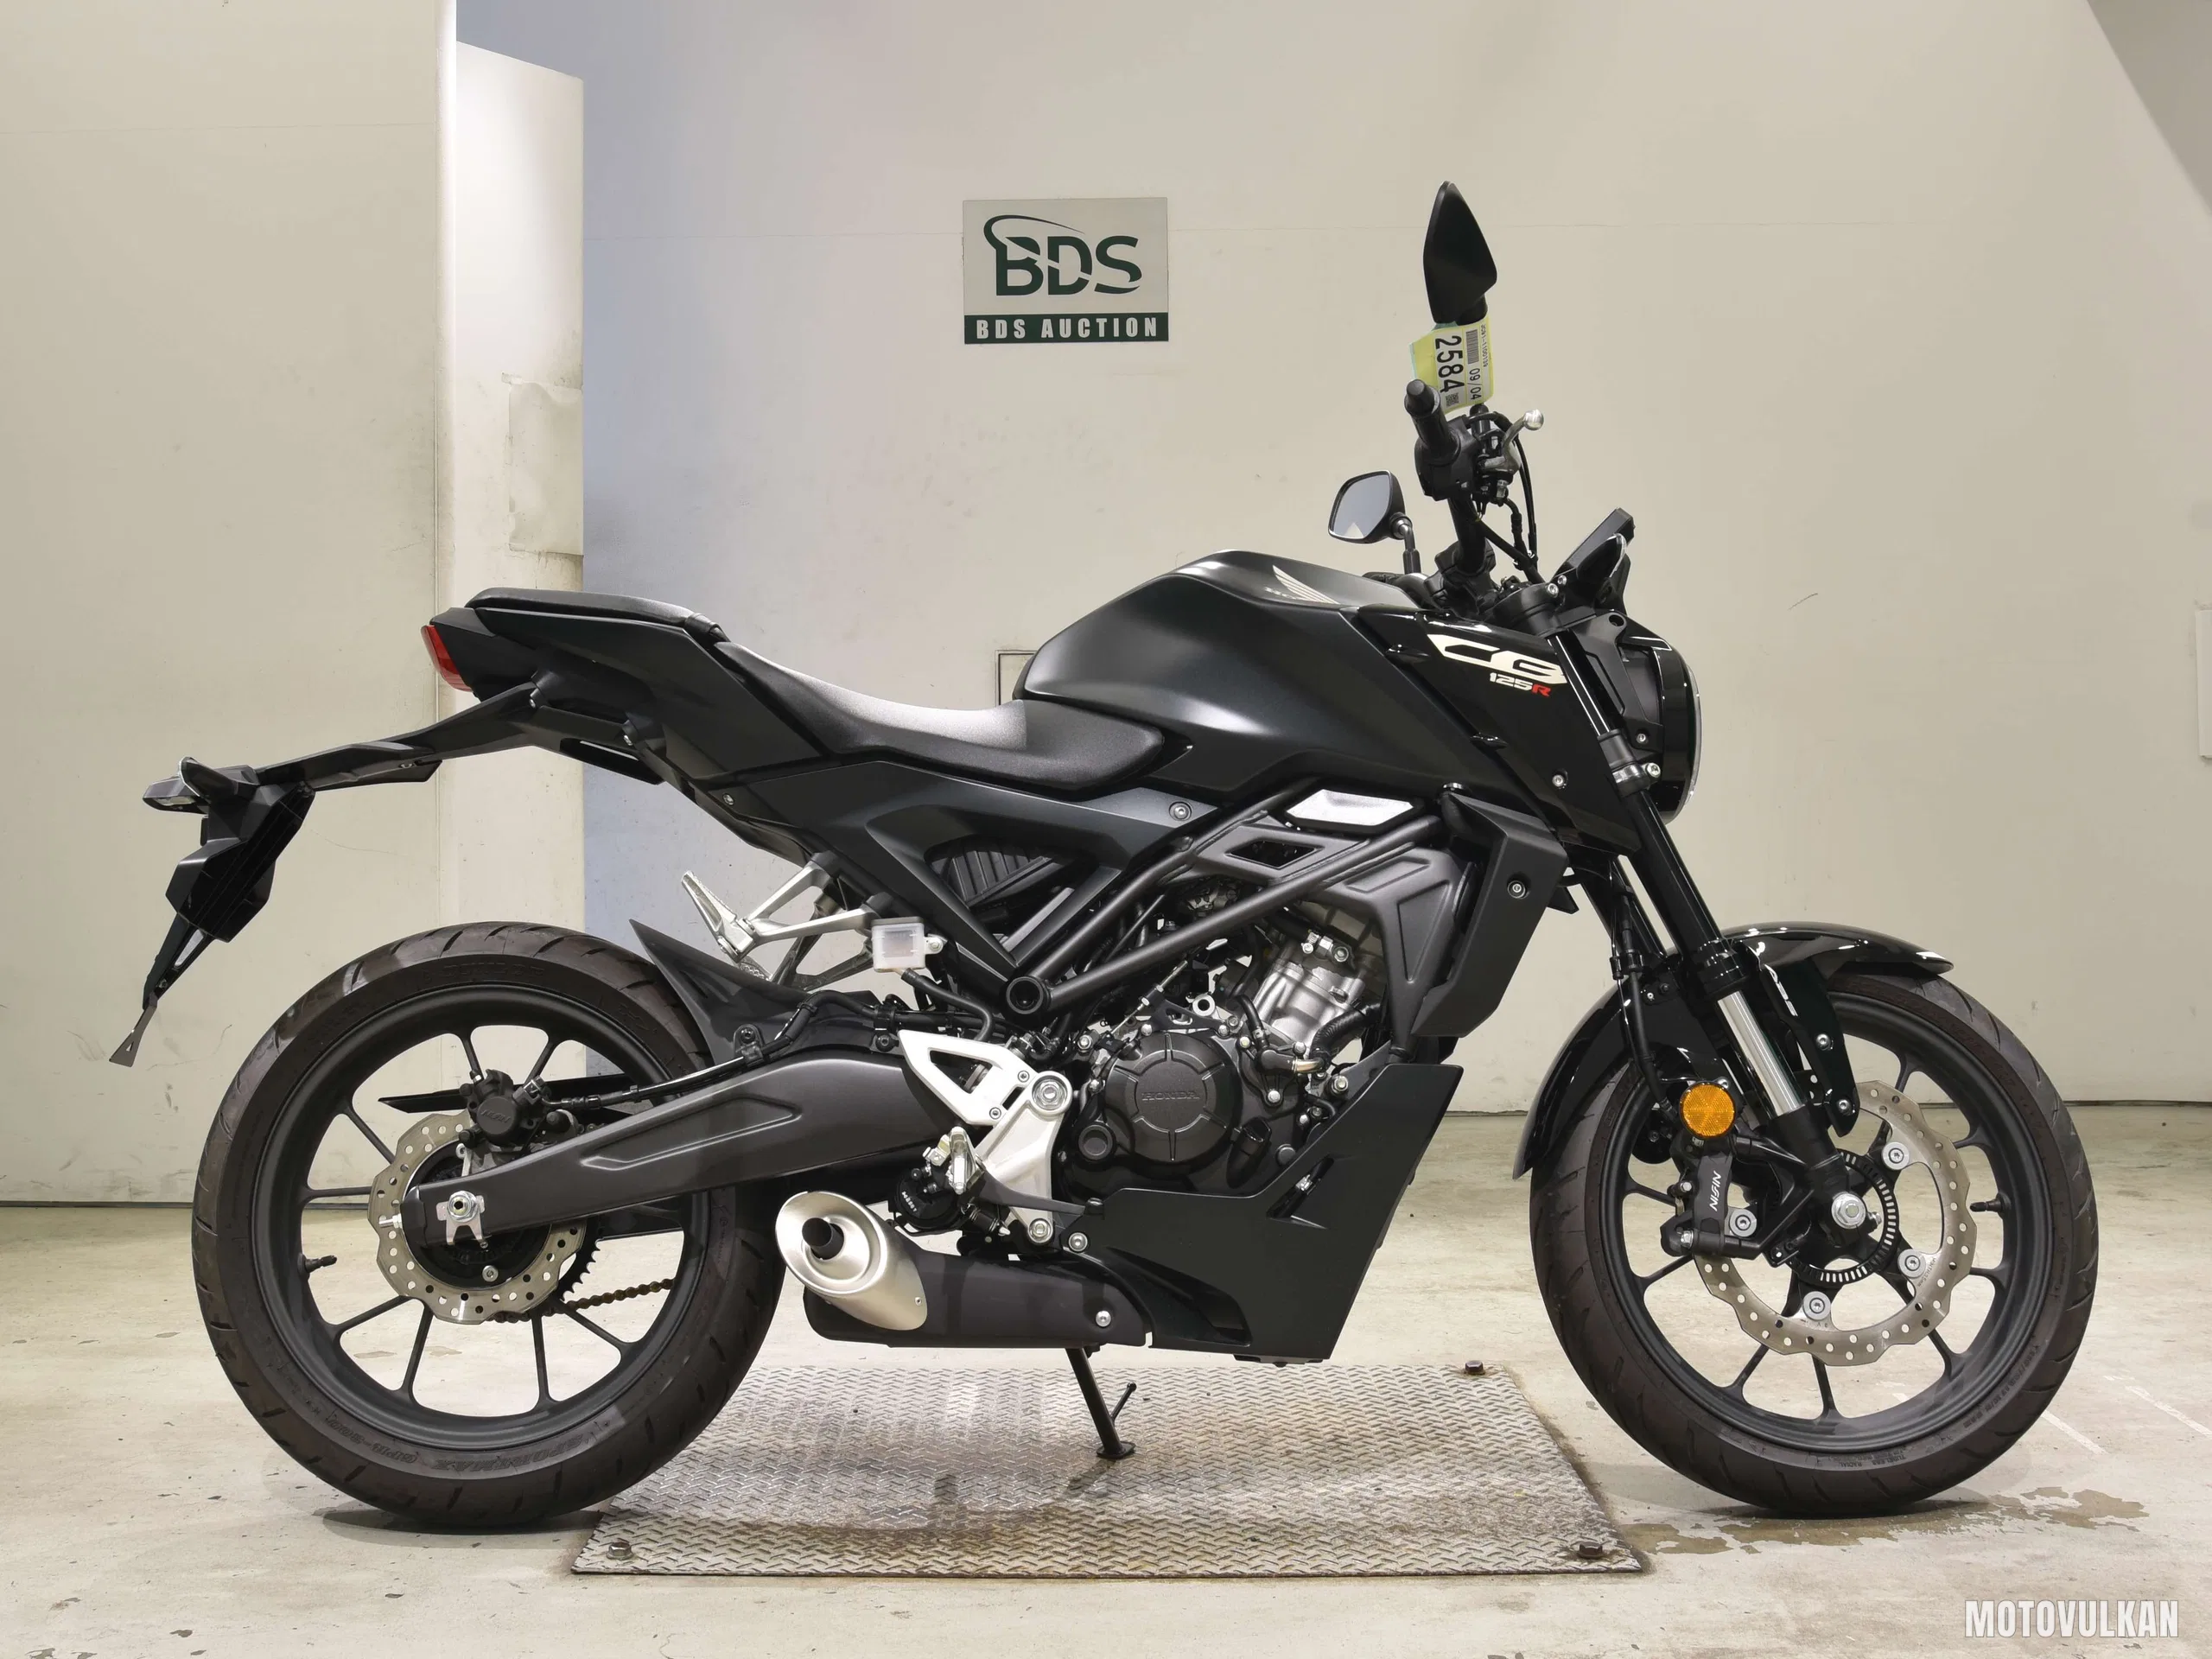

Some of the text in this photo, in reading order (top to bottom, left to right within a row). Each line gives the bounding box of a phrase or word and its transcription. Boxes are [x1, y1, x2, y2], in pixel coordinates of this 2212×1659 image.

[983, 214, 1142, 296] BDS
[976, 317, 1157, 340] BDS AUCTION
[1434, 335, 1465, 393] 2584
[1467, 367, 1483, 400] 09/04
[1490, 672, 1552, 697] 125R
[1141, 1090, 1200, 1102] HONDA
[1709, 1170, 1722, 1211] NISSIN
